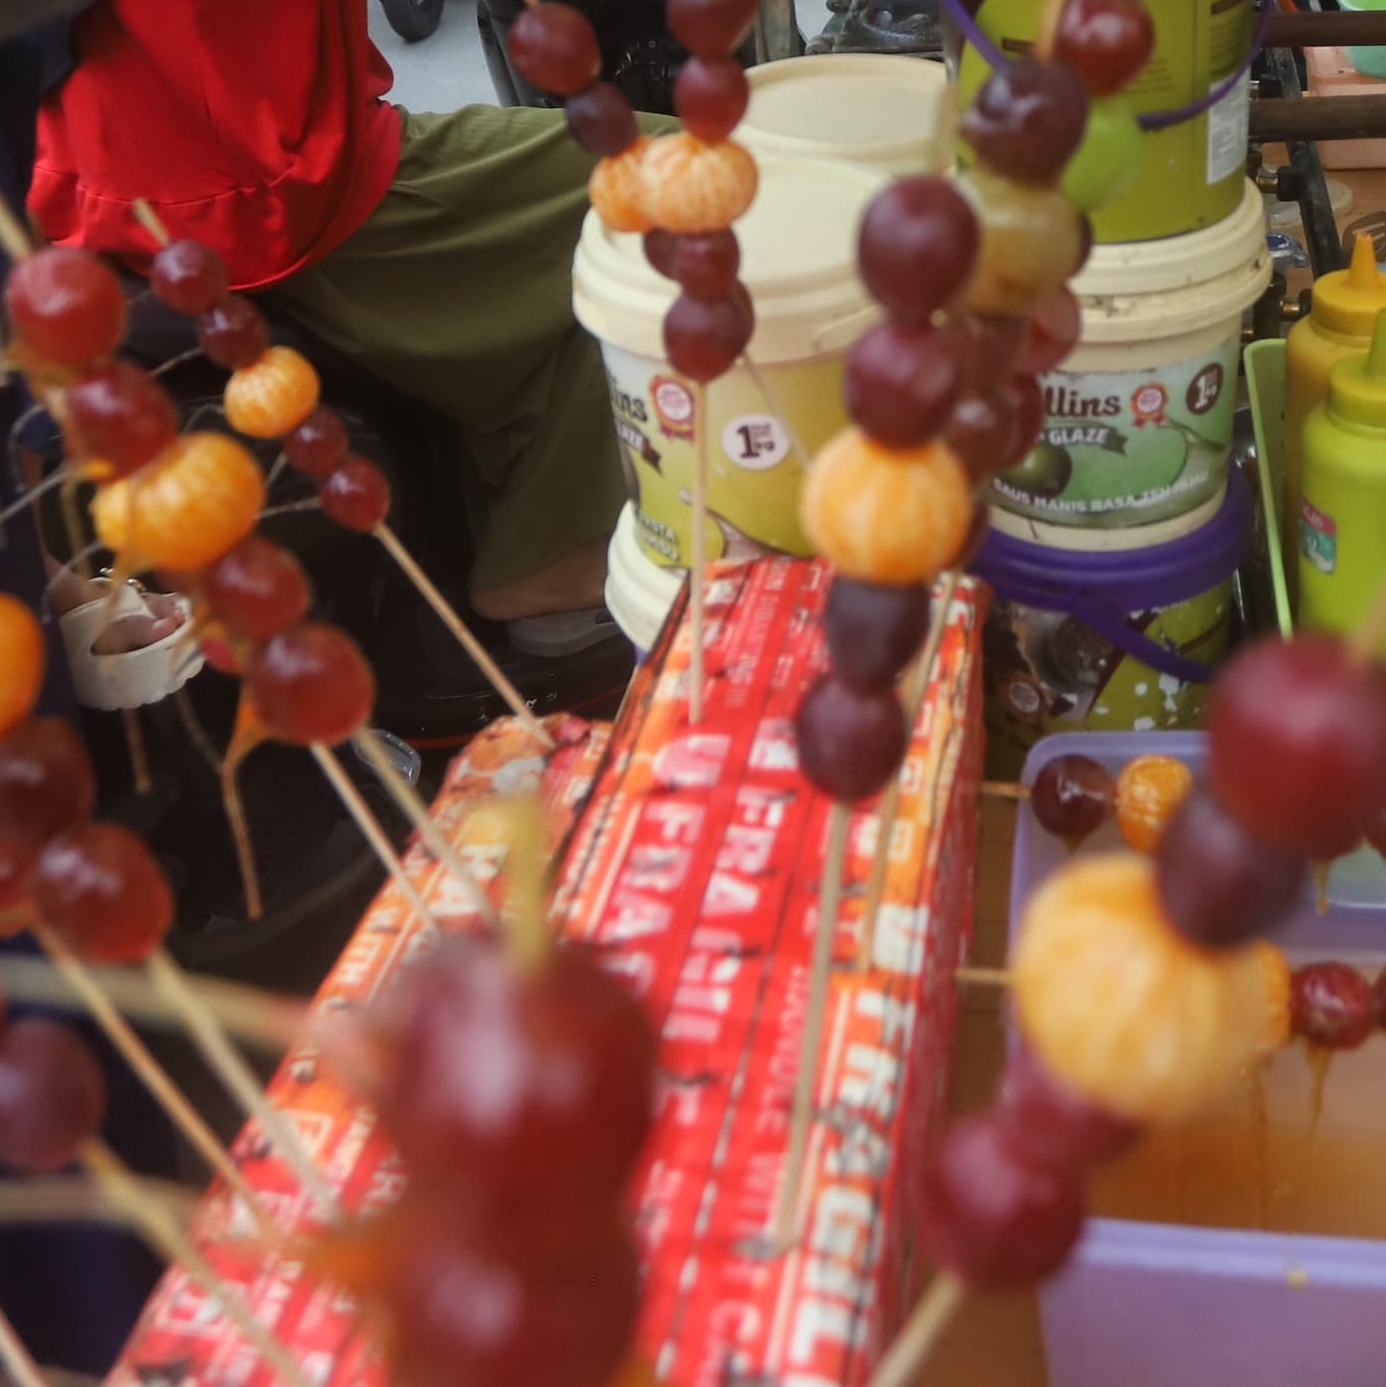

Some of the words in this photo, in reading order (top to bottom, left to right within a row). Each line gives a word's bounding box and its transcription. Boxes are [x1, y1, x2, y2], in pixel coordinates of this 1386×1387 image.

[1044, 385, 1121, 416] llins
[1048, 427, 1111, 447] GLAZE
[1033, 495, 1087, 513] MANIS
[778, 988, 918, 1387] FRAGIL
